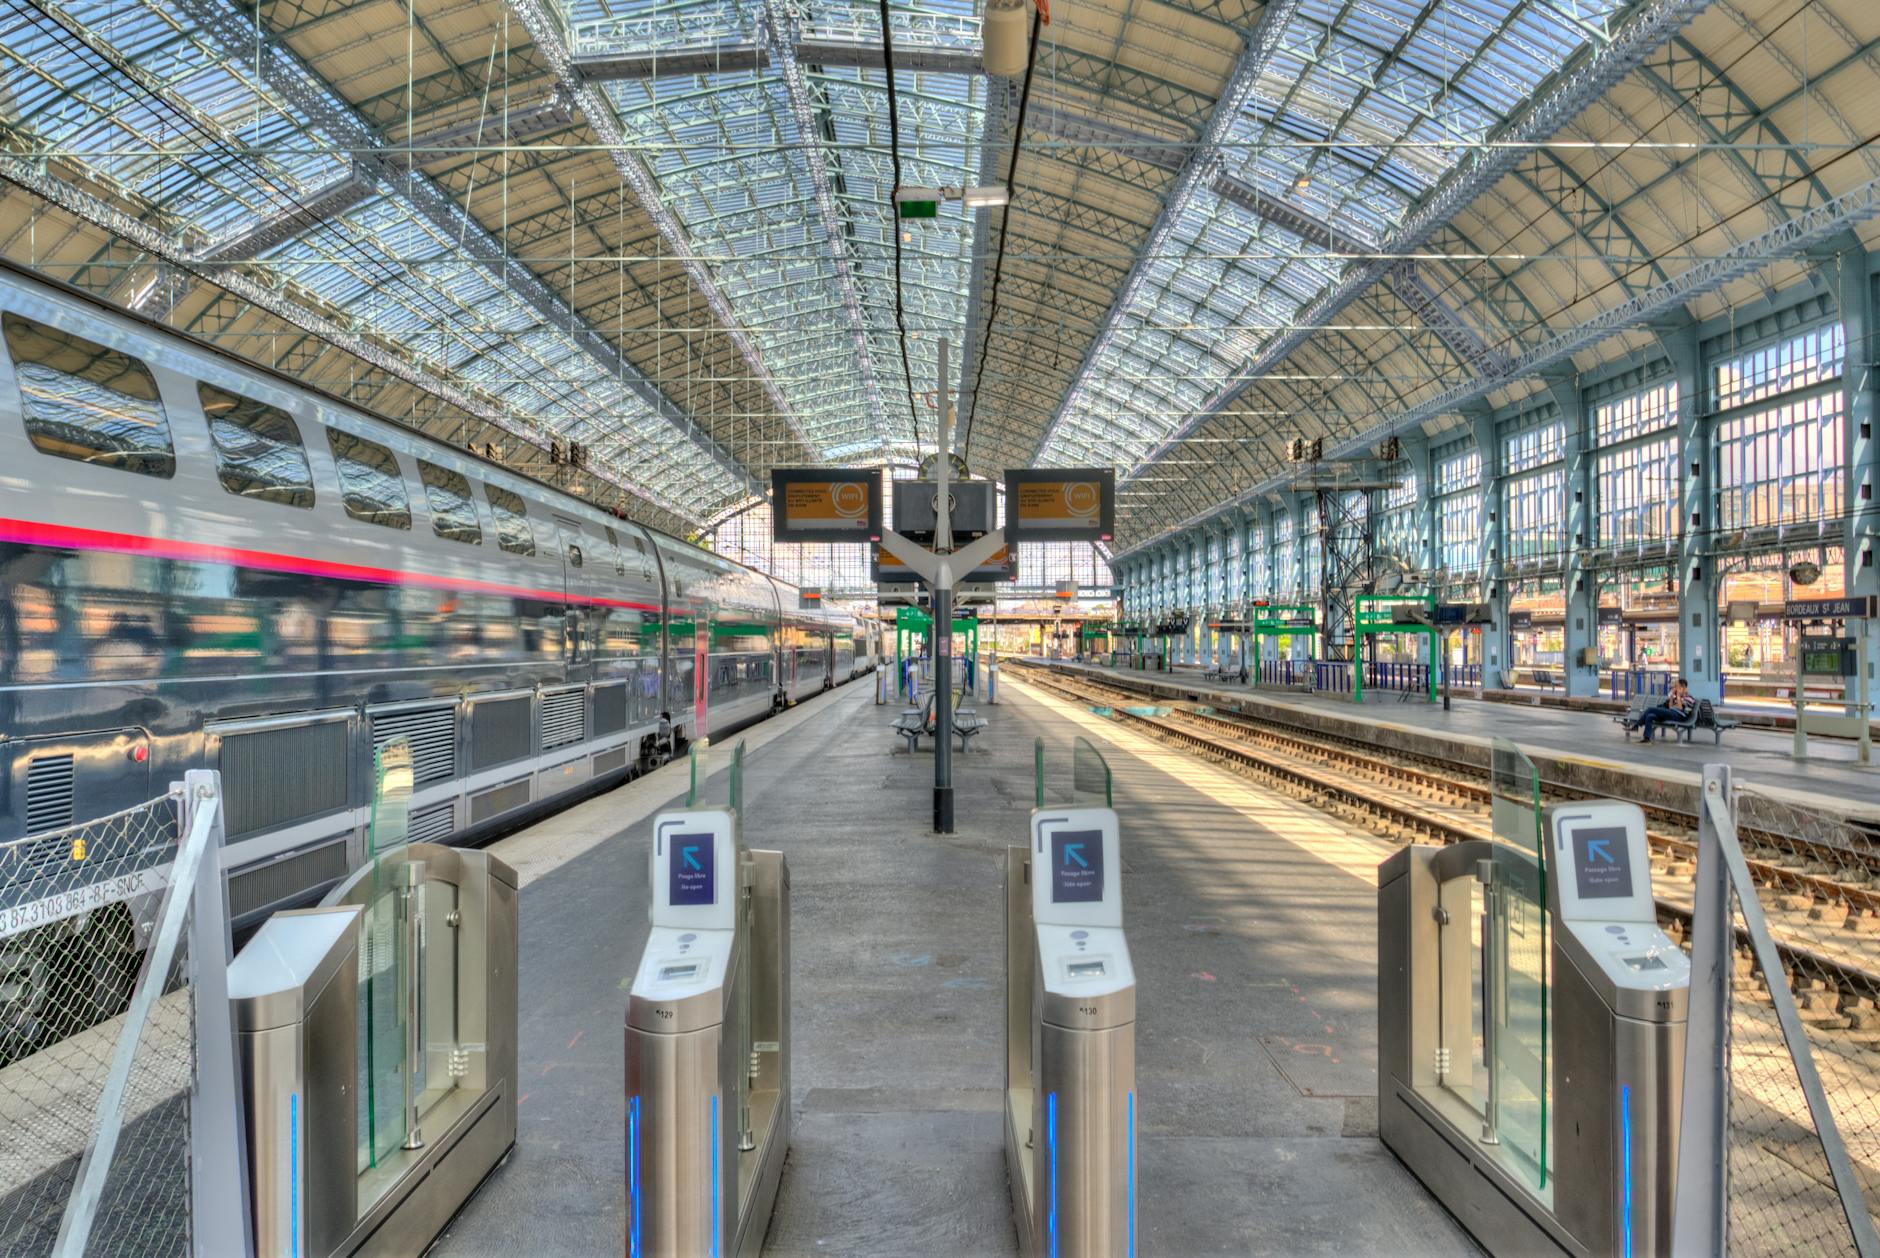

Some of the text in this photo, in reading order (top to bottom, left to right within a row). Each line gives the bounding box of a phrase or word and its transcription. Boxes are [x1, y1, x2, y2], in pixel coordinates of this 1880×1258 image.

[1786, 604, 1819, 615] BORDEAUX
[1833, 602, 1850, 614] JEAN
[11, 907, 28, 928] 87
[661, 1010, 673, 1019] 129
